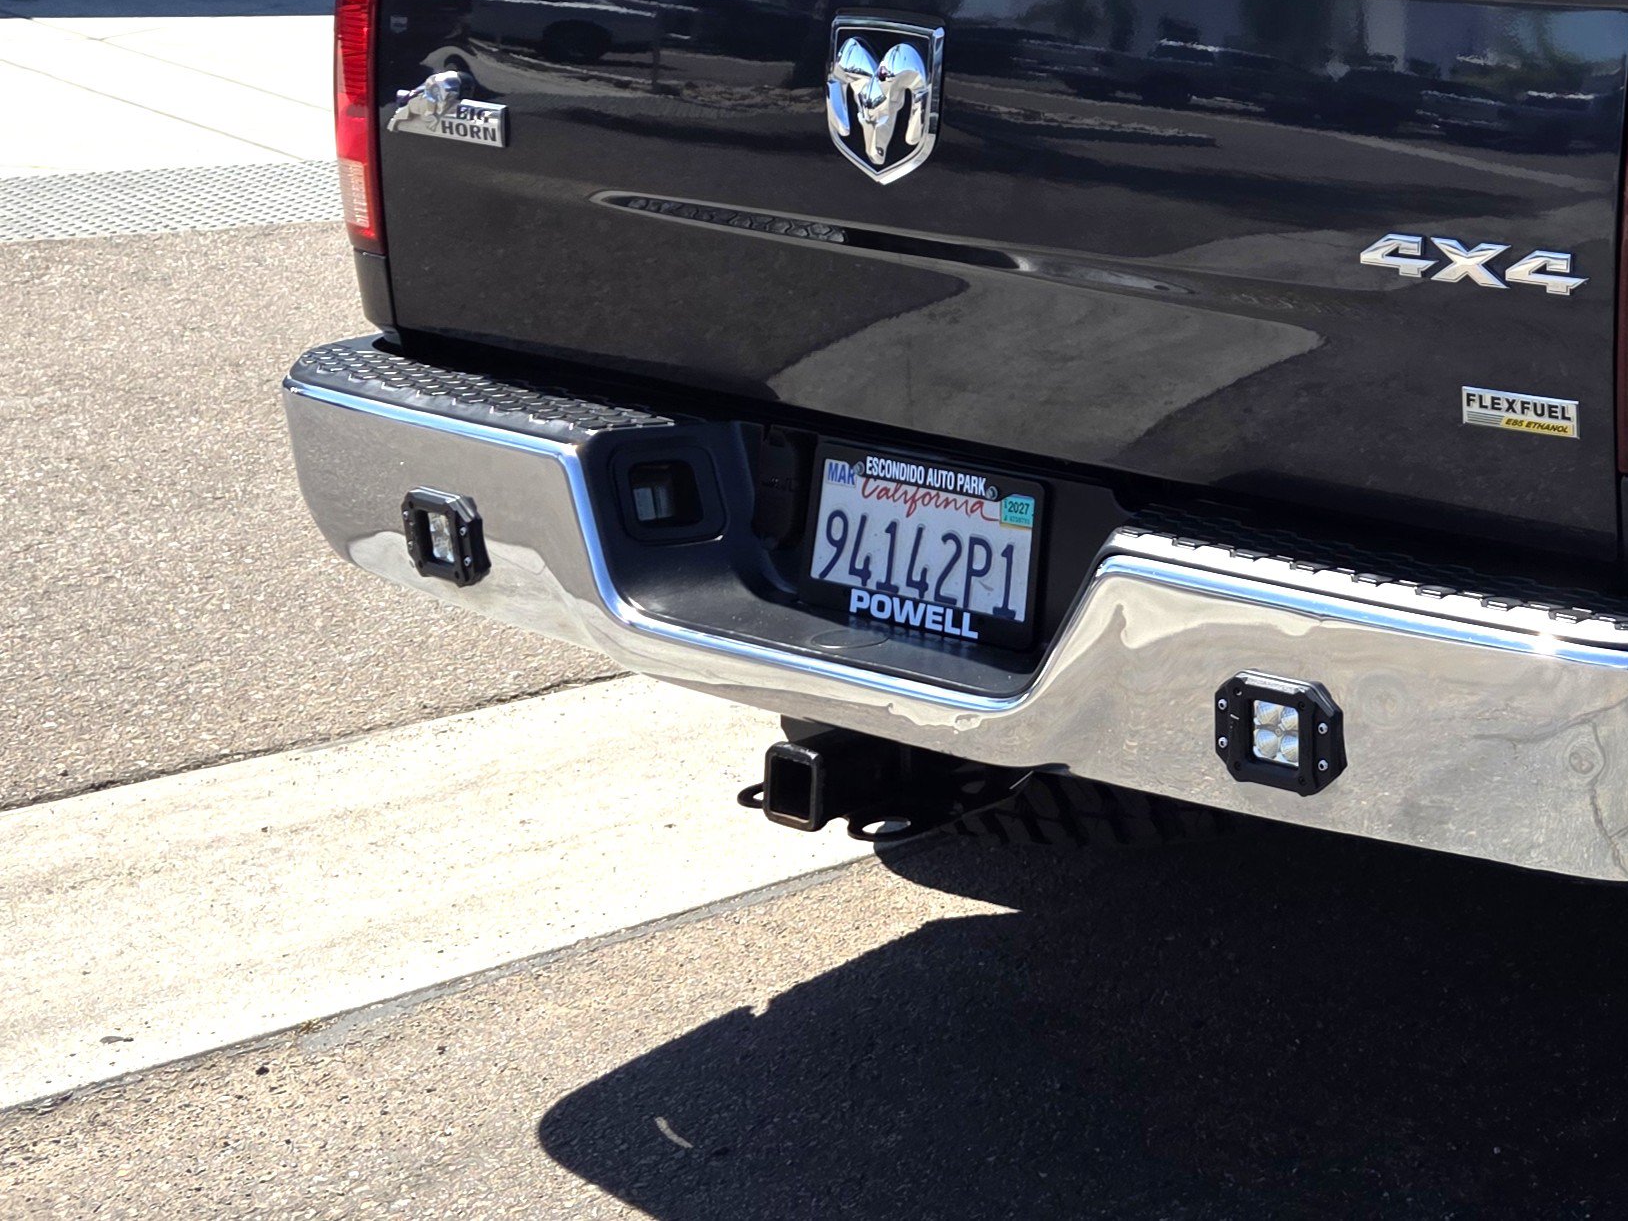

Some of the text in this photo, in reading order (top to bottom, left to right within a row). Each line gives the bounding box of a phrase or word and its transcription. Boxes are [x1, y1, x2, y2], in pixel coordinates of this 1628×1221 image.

[457, 105, 493, 122] BIG
[441, 120, 497, 142] HORN
[1466, 393, 1572, 421] FLEXFUEL
[1505, 418, 1569, 434] E85 ETHANOL
[828, 461, 855, 485] MAR
[866, 456, 986, 496] ESCONDIDO AUTO PARK
[861, 478, 1000, 522] California
[1008, 500, 1030, 515] 2027
[818, 509, 1016, 620] 94142P1
[849, 589, 978, 639] POWELL
